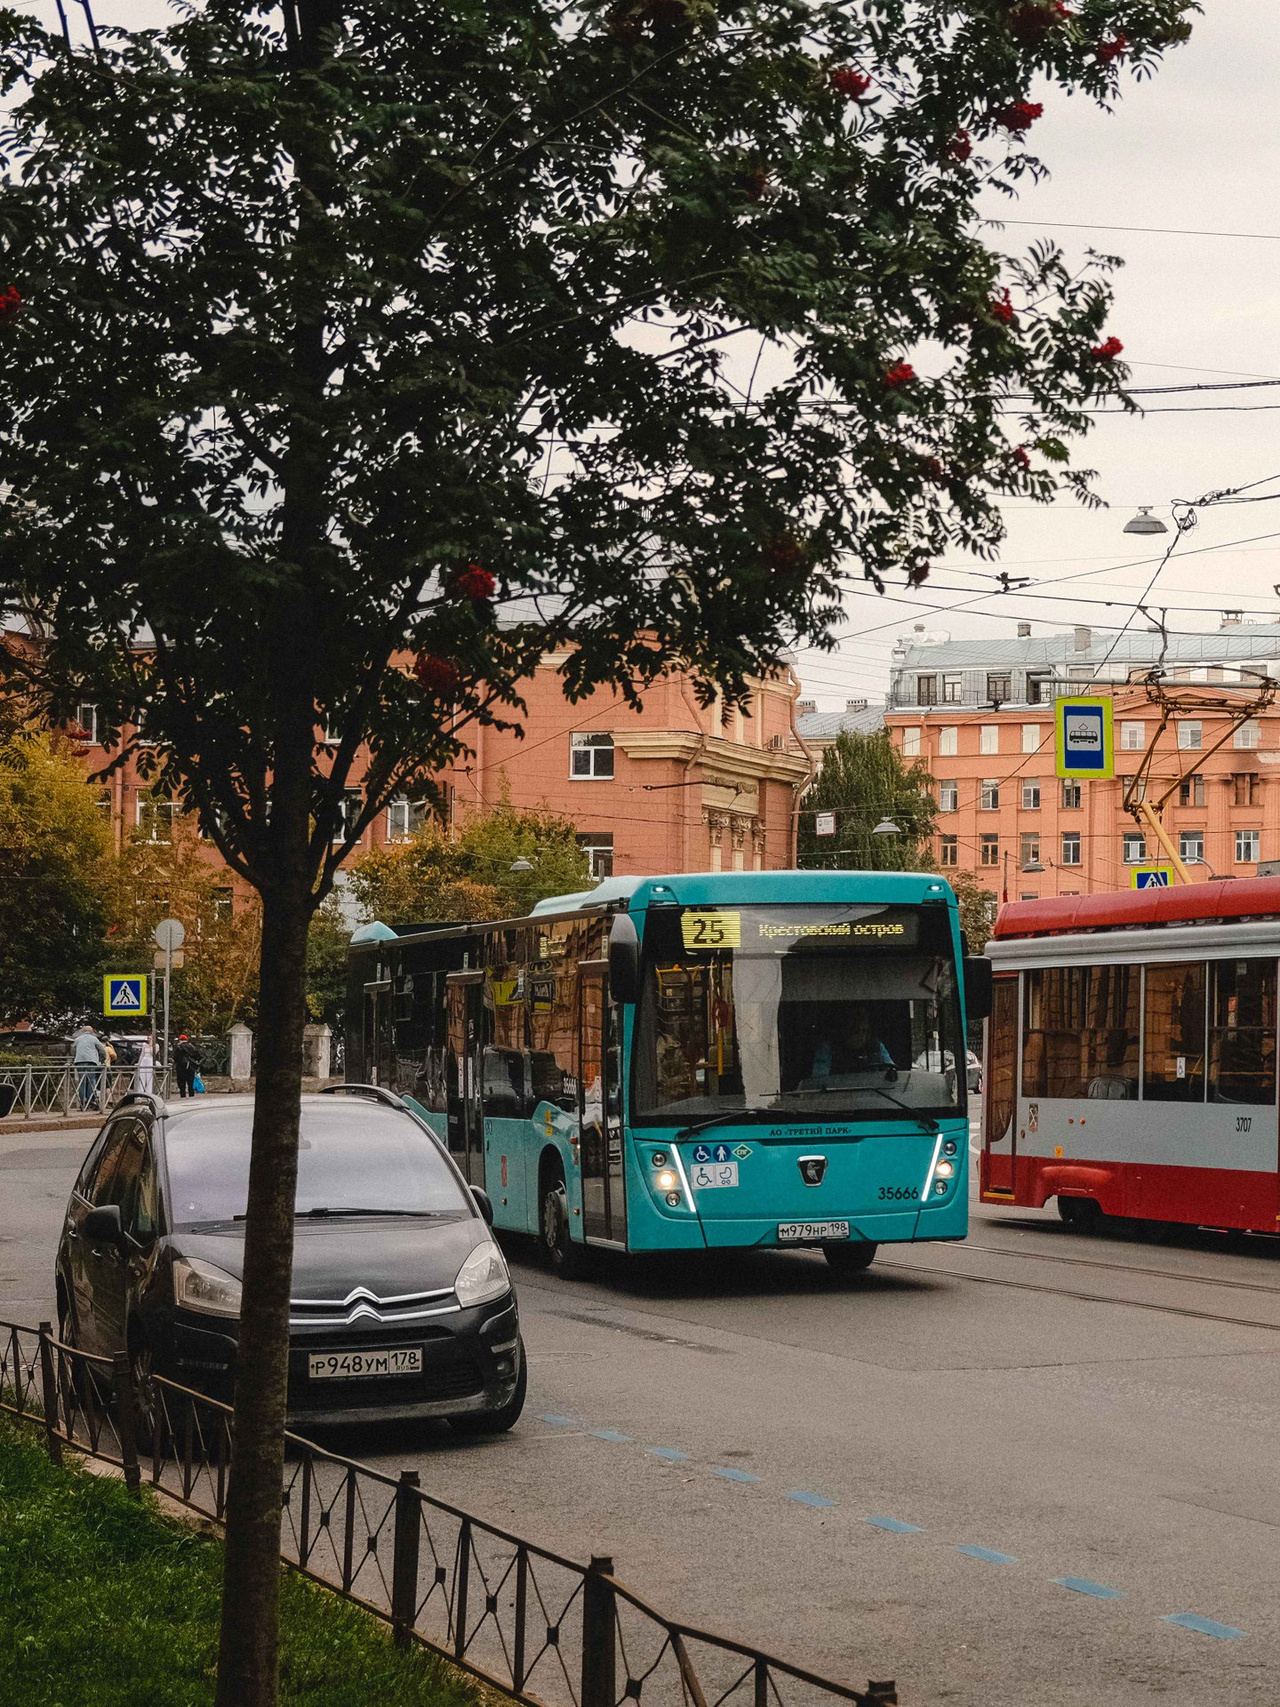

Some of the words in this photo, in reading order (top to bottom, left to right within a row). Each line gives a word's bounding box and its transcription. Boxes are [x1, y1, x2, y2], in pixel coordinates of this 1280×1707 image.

[693, 919, 724, 944] 25
[759, 923, 851, 939] Крестовский
[854, 924, 904, 937] остров
[1235, 1116, 1252, 1133] 3707
[877, 1187, 919, 1200] 35666
[780, 1224, 827, 1237] М979НР
[829, 1222, 846, 1232] 198
[315, 1355, 388, 1375] Р948УМ
[391, 1351, 416, 1366] 178
